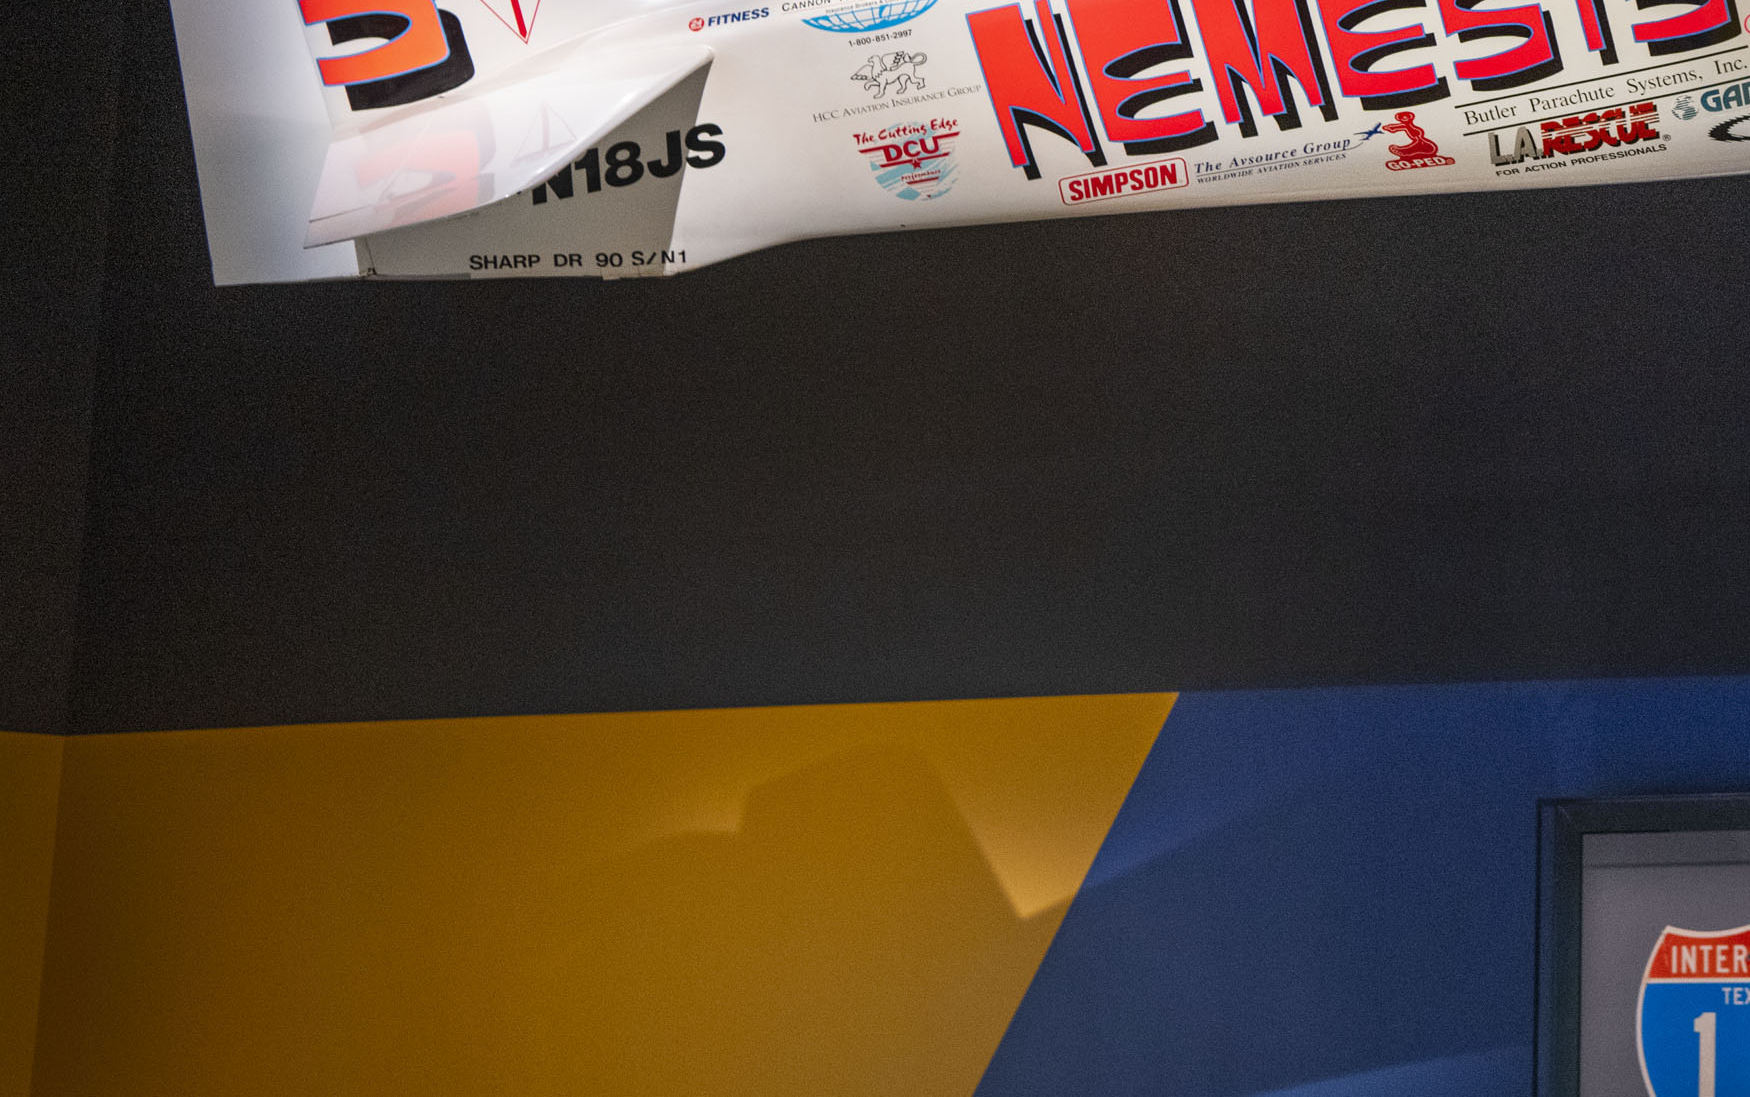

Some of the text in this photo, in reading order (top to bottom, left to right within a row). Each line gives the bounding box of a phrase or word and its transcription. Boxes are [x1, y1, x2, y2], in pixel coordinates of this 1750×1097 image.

[707, 7, 770, 27] FITNESS
[848, 29, 913, 47] 1-800-851-2997
[813, 84, 982, 123] HCC AVIATION INSURANCE GROUP
[1464, 55, 1749, 127] Butler Parachute Systems, Inc.
[852, 117, 959, 146] The Cutting Edge
[881, 136, 940, 163] DCU
[1194, 160, 1222, 175] The
[1303, 137, 1351, 155] Group
[1387, 156, 1446, 171] GO-PED
[1495, 143, 1668, 177] FOR ACTION PROFESSIONALS
[1068, 161, 1178, 202] SIMPSON
[1196, 152, 1348, 185] WORLDWIDE AVIATION SERVICES
[469, 254, 541, 270] SHARP
[553, 253, 583, 268] DR
[595, 252, 623, 268] 90
